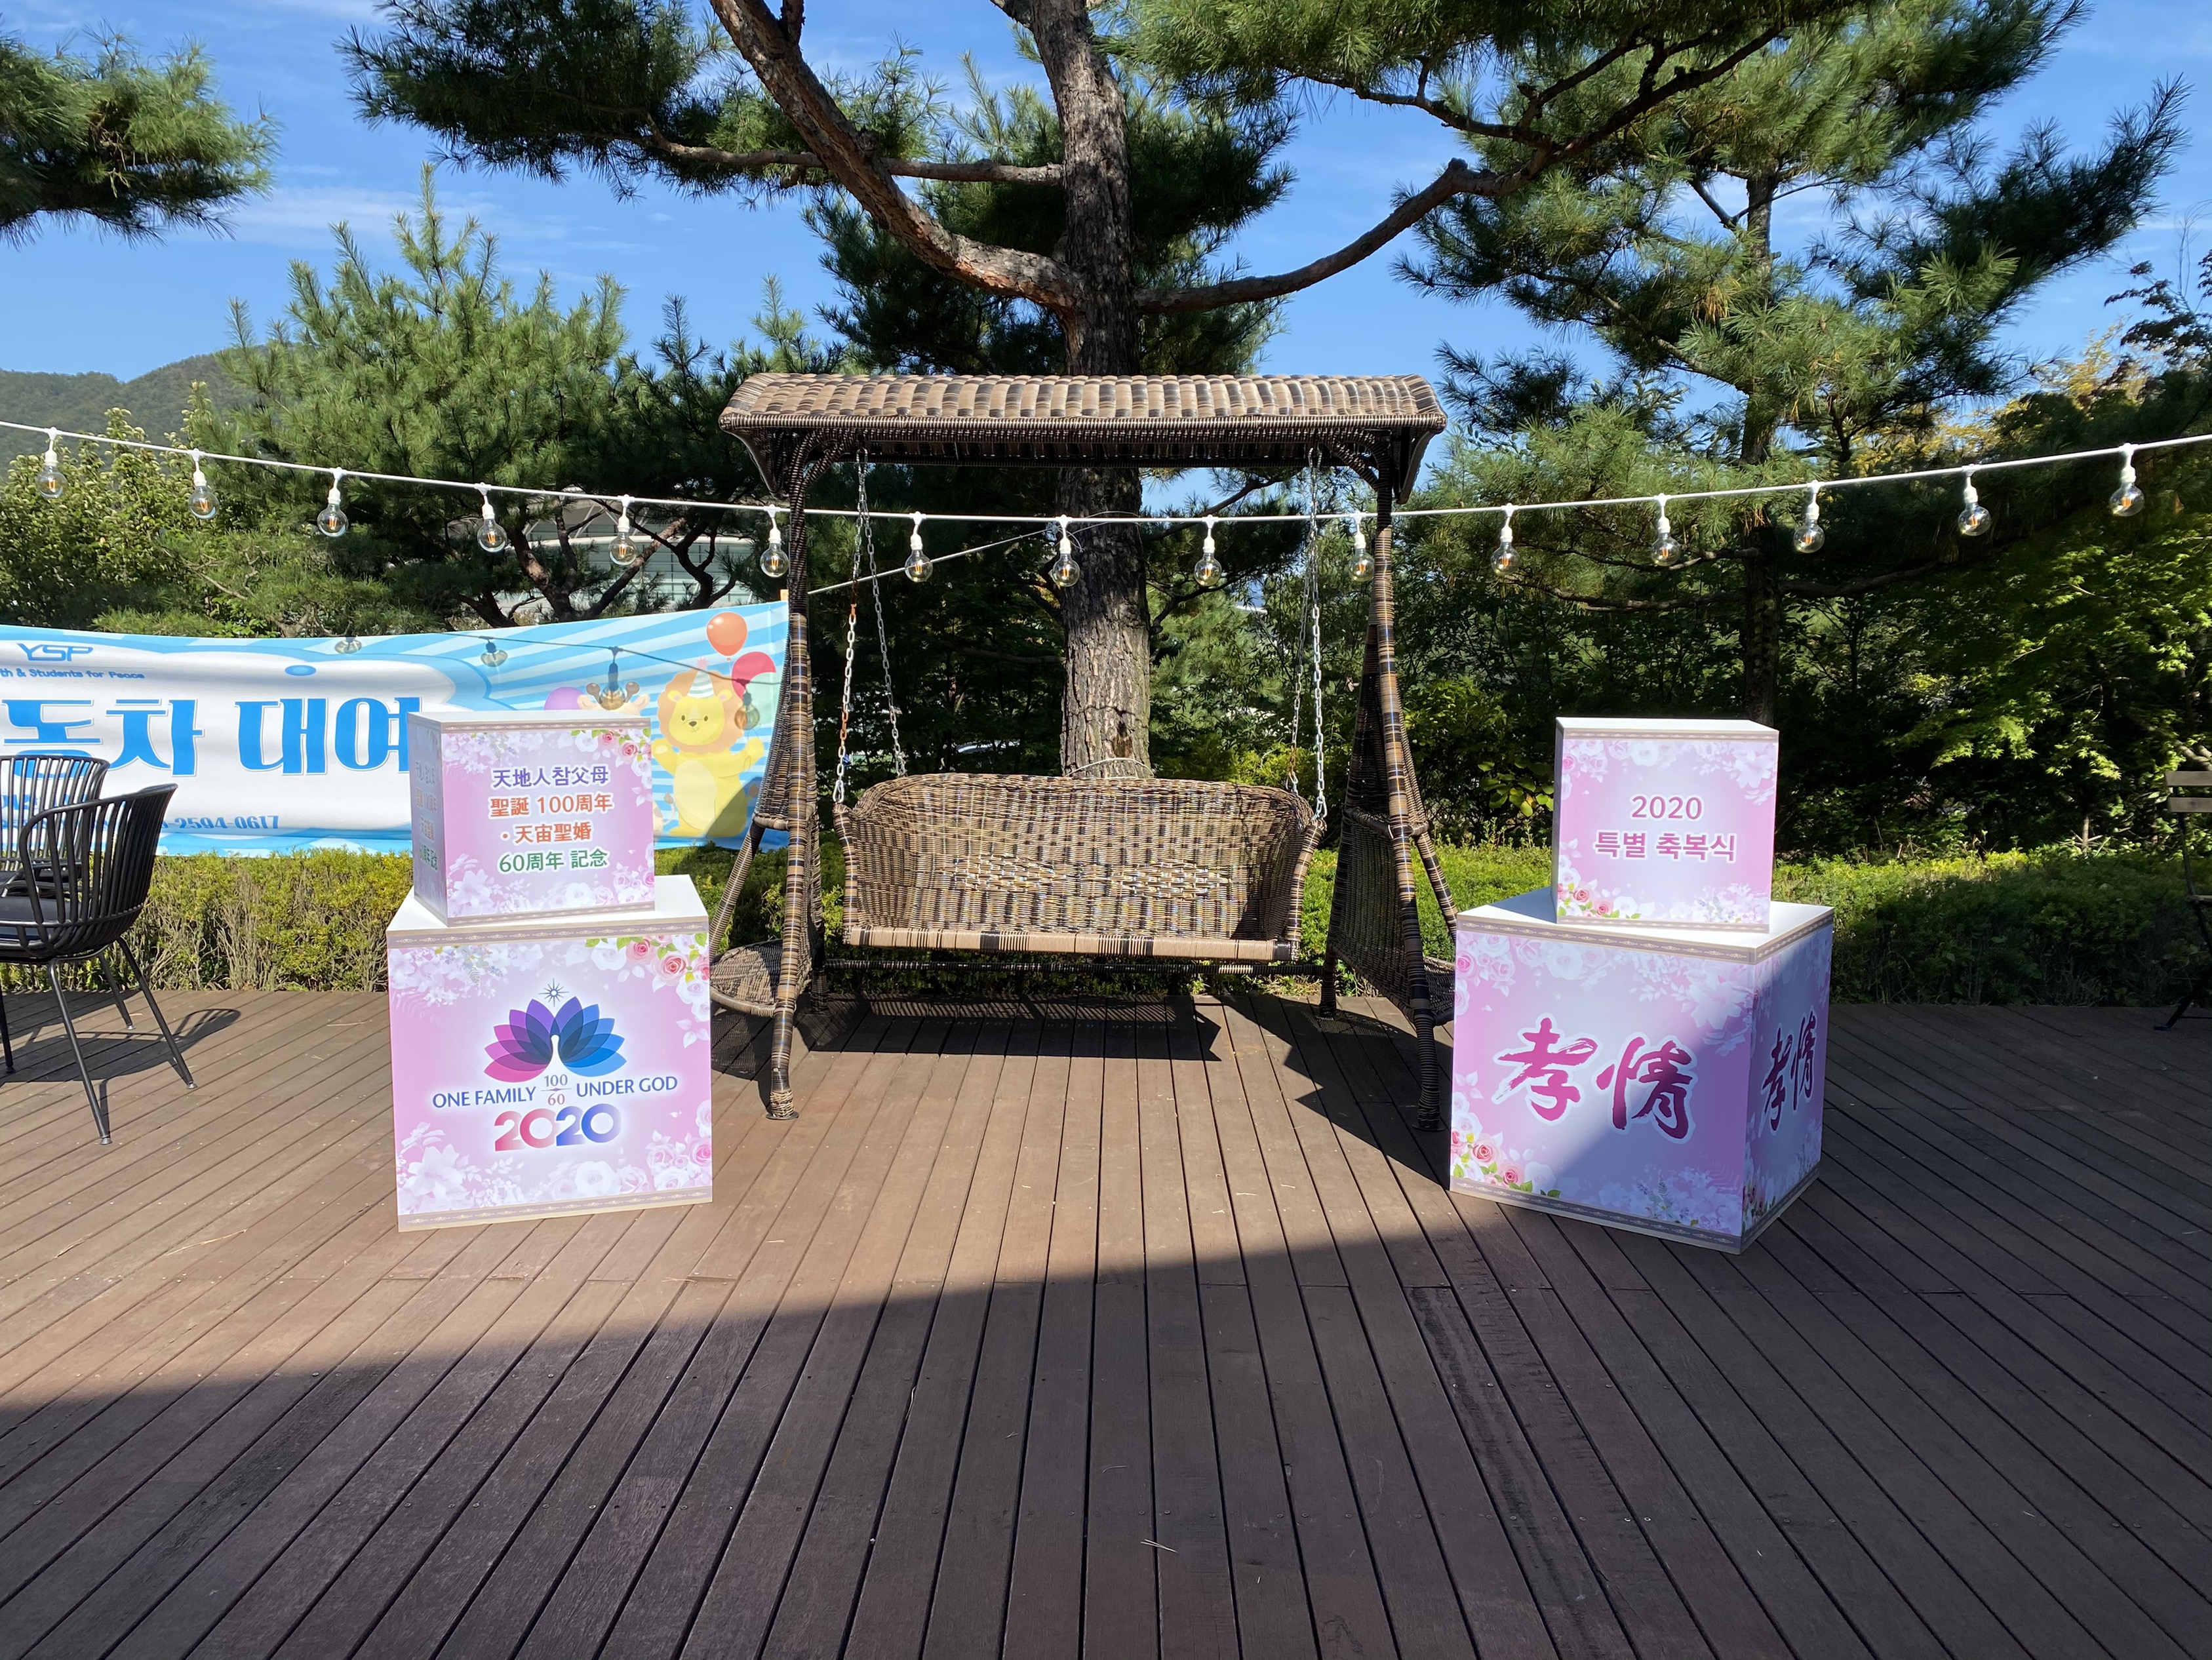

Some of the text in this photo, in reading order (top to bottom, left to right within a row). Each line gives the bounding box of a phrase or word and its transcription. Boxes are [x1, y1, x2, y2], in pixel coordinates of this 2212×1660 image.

[16, 643, 93, 662] YSP
[16, 667, 26, 678] &
[30, 669, 83, 678] Students
[109, 671, 146, 679] Peace
[493, 766, 608, 787] 天地人참父母
[490, 793, 612, 817] 聖誕 100周年
[1632, 795, 1702, 820] 2020
[1595, 831, 1735, 861] 특별 축복식
[499, 848, 608, 873] 60周年 記念
[432, 1075, 678, 1109] ONE FAMILY UNDER GOD
[543, 1074, 568, 1087] 100
[547, 1093, 566, 1106] 60
[494, 1103, 622, 1152] 2020
